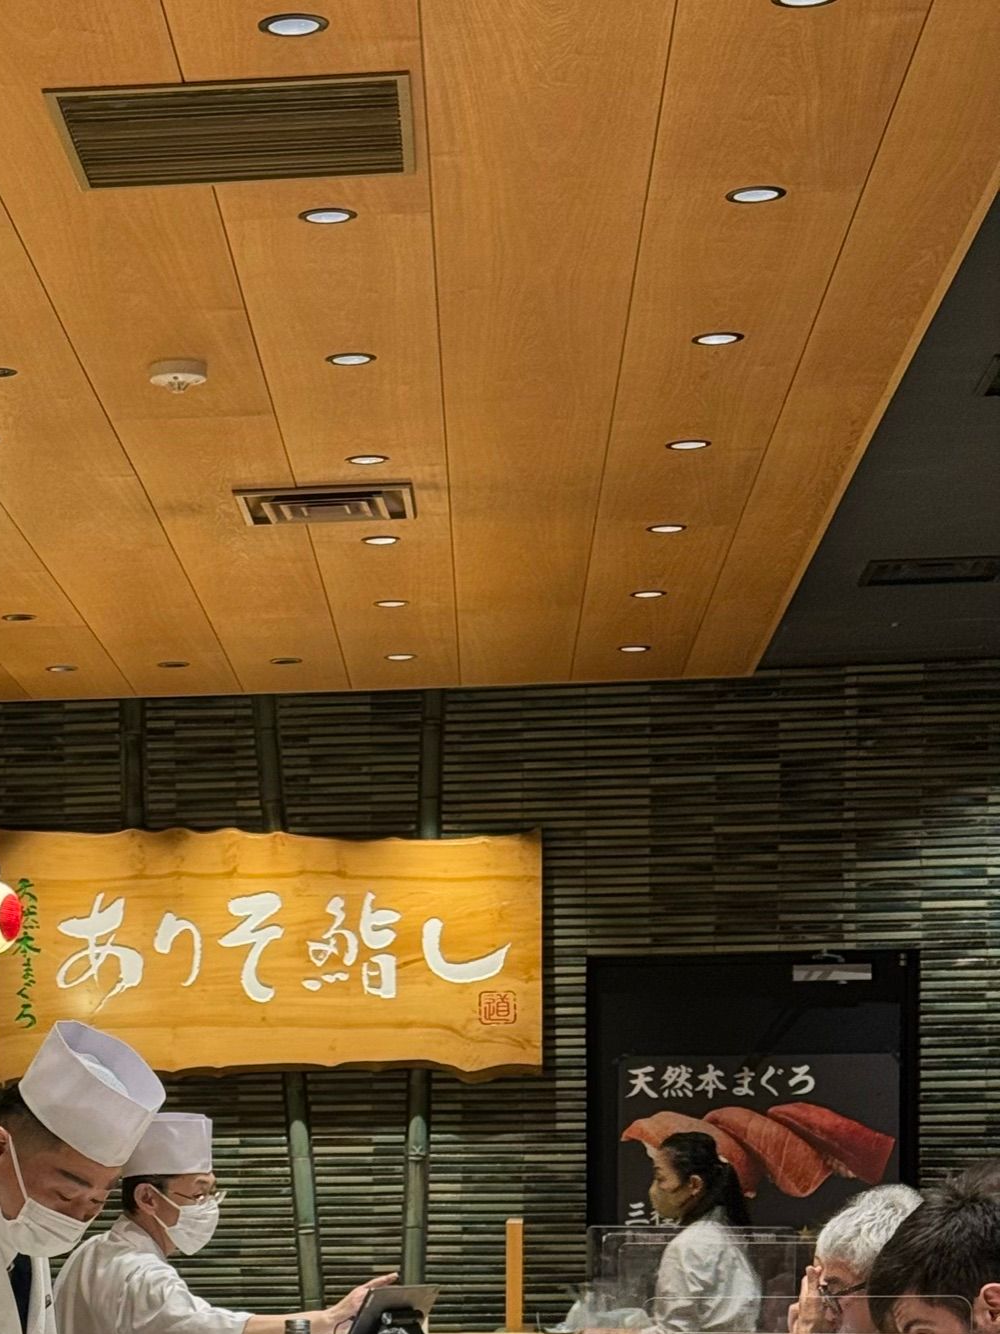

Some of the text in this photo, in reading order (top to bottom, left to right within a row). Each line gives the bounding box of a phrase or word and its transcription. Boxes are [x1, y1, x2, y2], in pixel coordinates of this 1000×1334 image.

[56, 890, 512, 1014] ありそ鮨し
[624, 1063, 816, 1100] 天然本まぐろ
